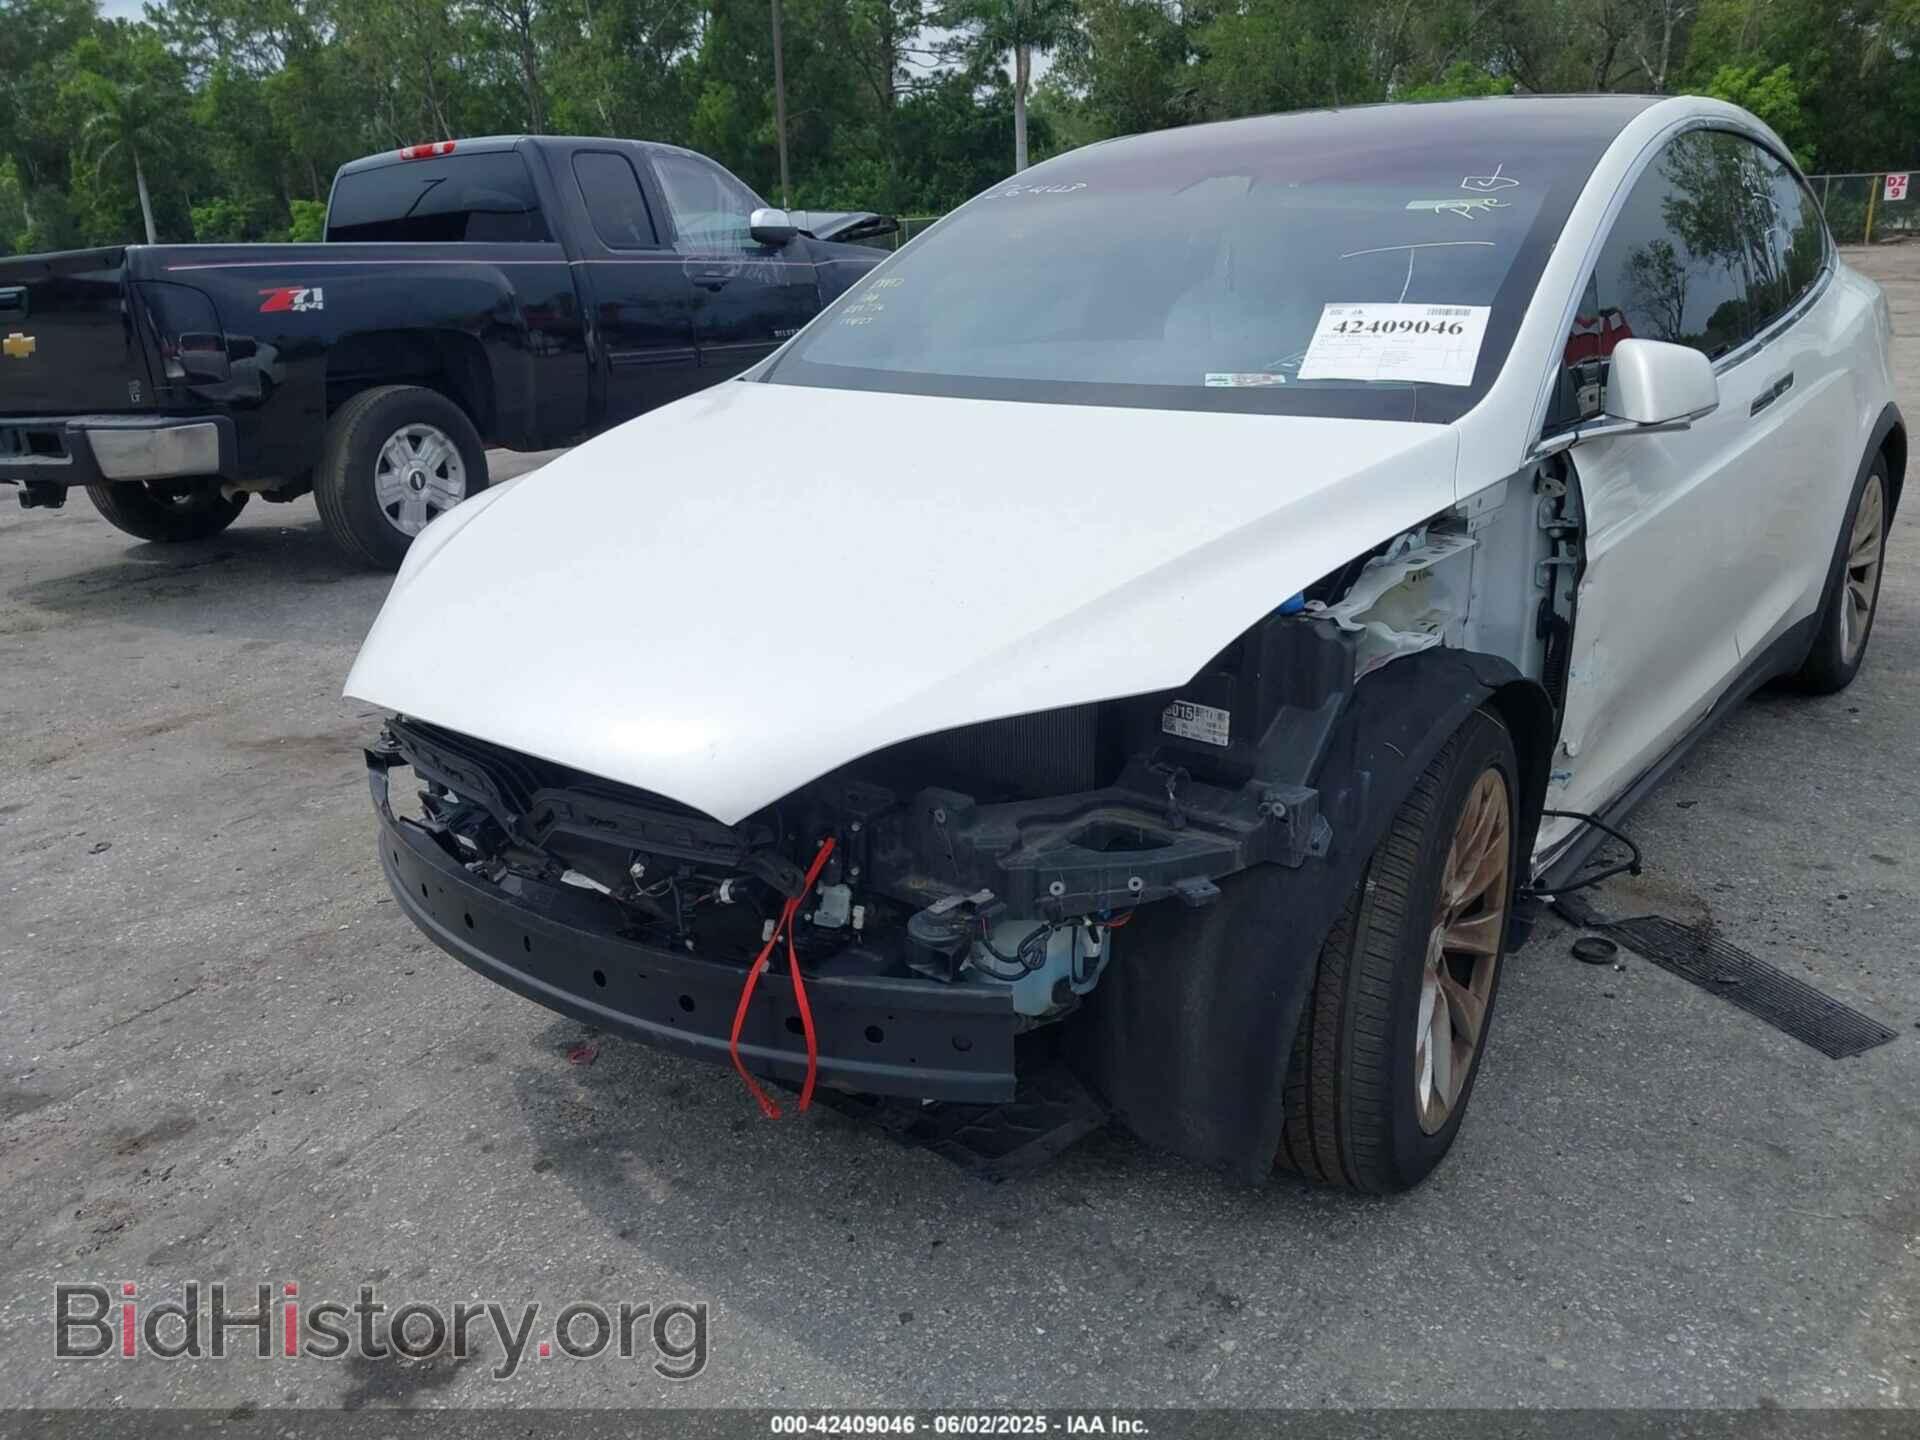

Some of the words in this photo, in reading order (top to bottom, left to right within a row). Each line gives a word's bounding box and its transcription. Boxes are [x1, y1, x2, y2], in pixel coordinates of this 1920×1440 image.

[1887, 176, 1905, 187] DZ
[1891, 188, 1900, 198] 9
[257, 287, 323, 312] Z71
[1333, 319, 1463, 335] 42409046
